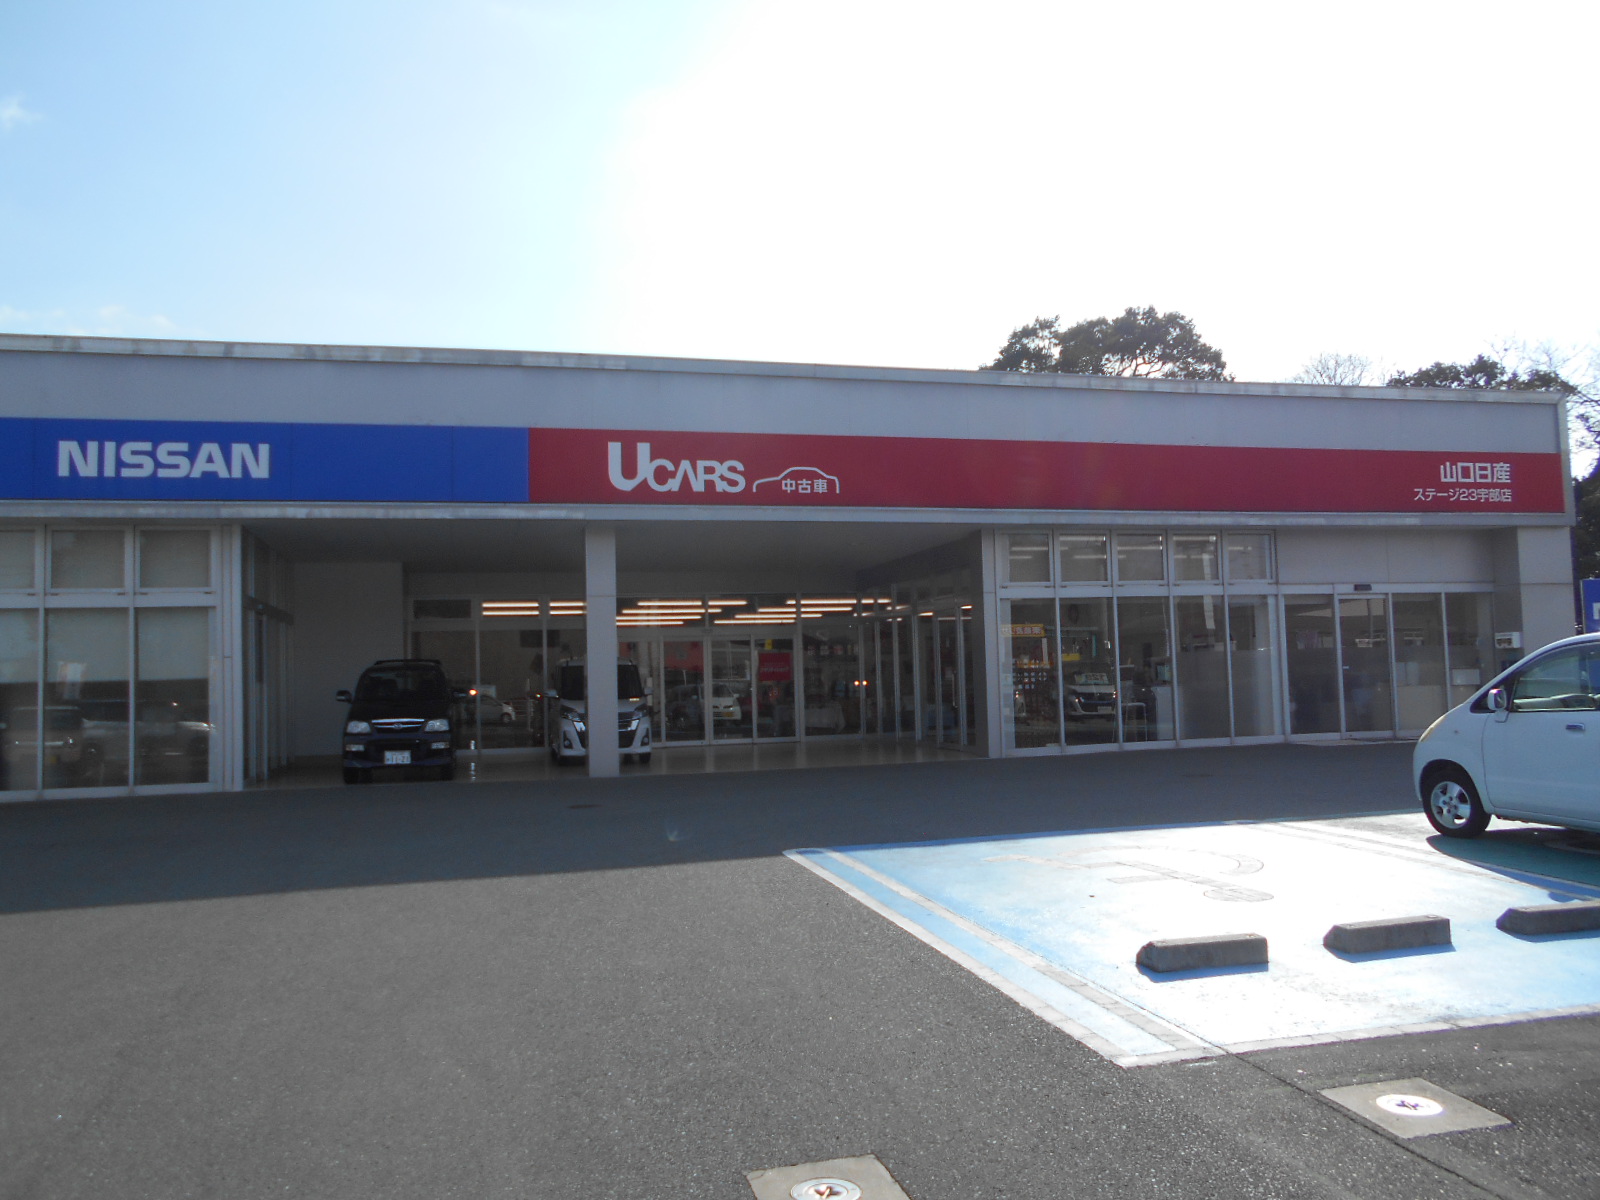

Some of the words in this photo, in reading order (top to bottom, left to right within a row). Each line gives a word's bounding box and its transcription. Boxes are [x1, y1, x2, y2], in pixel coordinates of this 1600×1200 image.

[58, 440, 270, 479] NISSAN
[1440, 461, 1511, 483] 山口日産
[781, 478, 828, 494] 中古車
[1413, 487, 1513, 502] ステージ23宇部店
